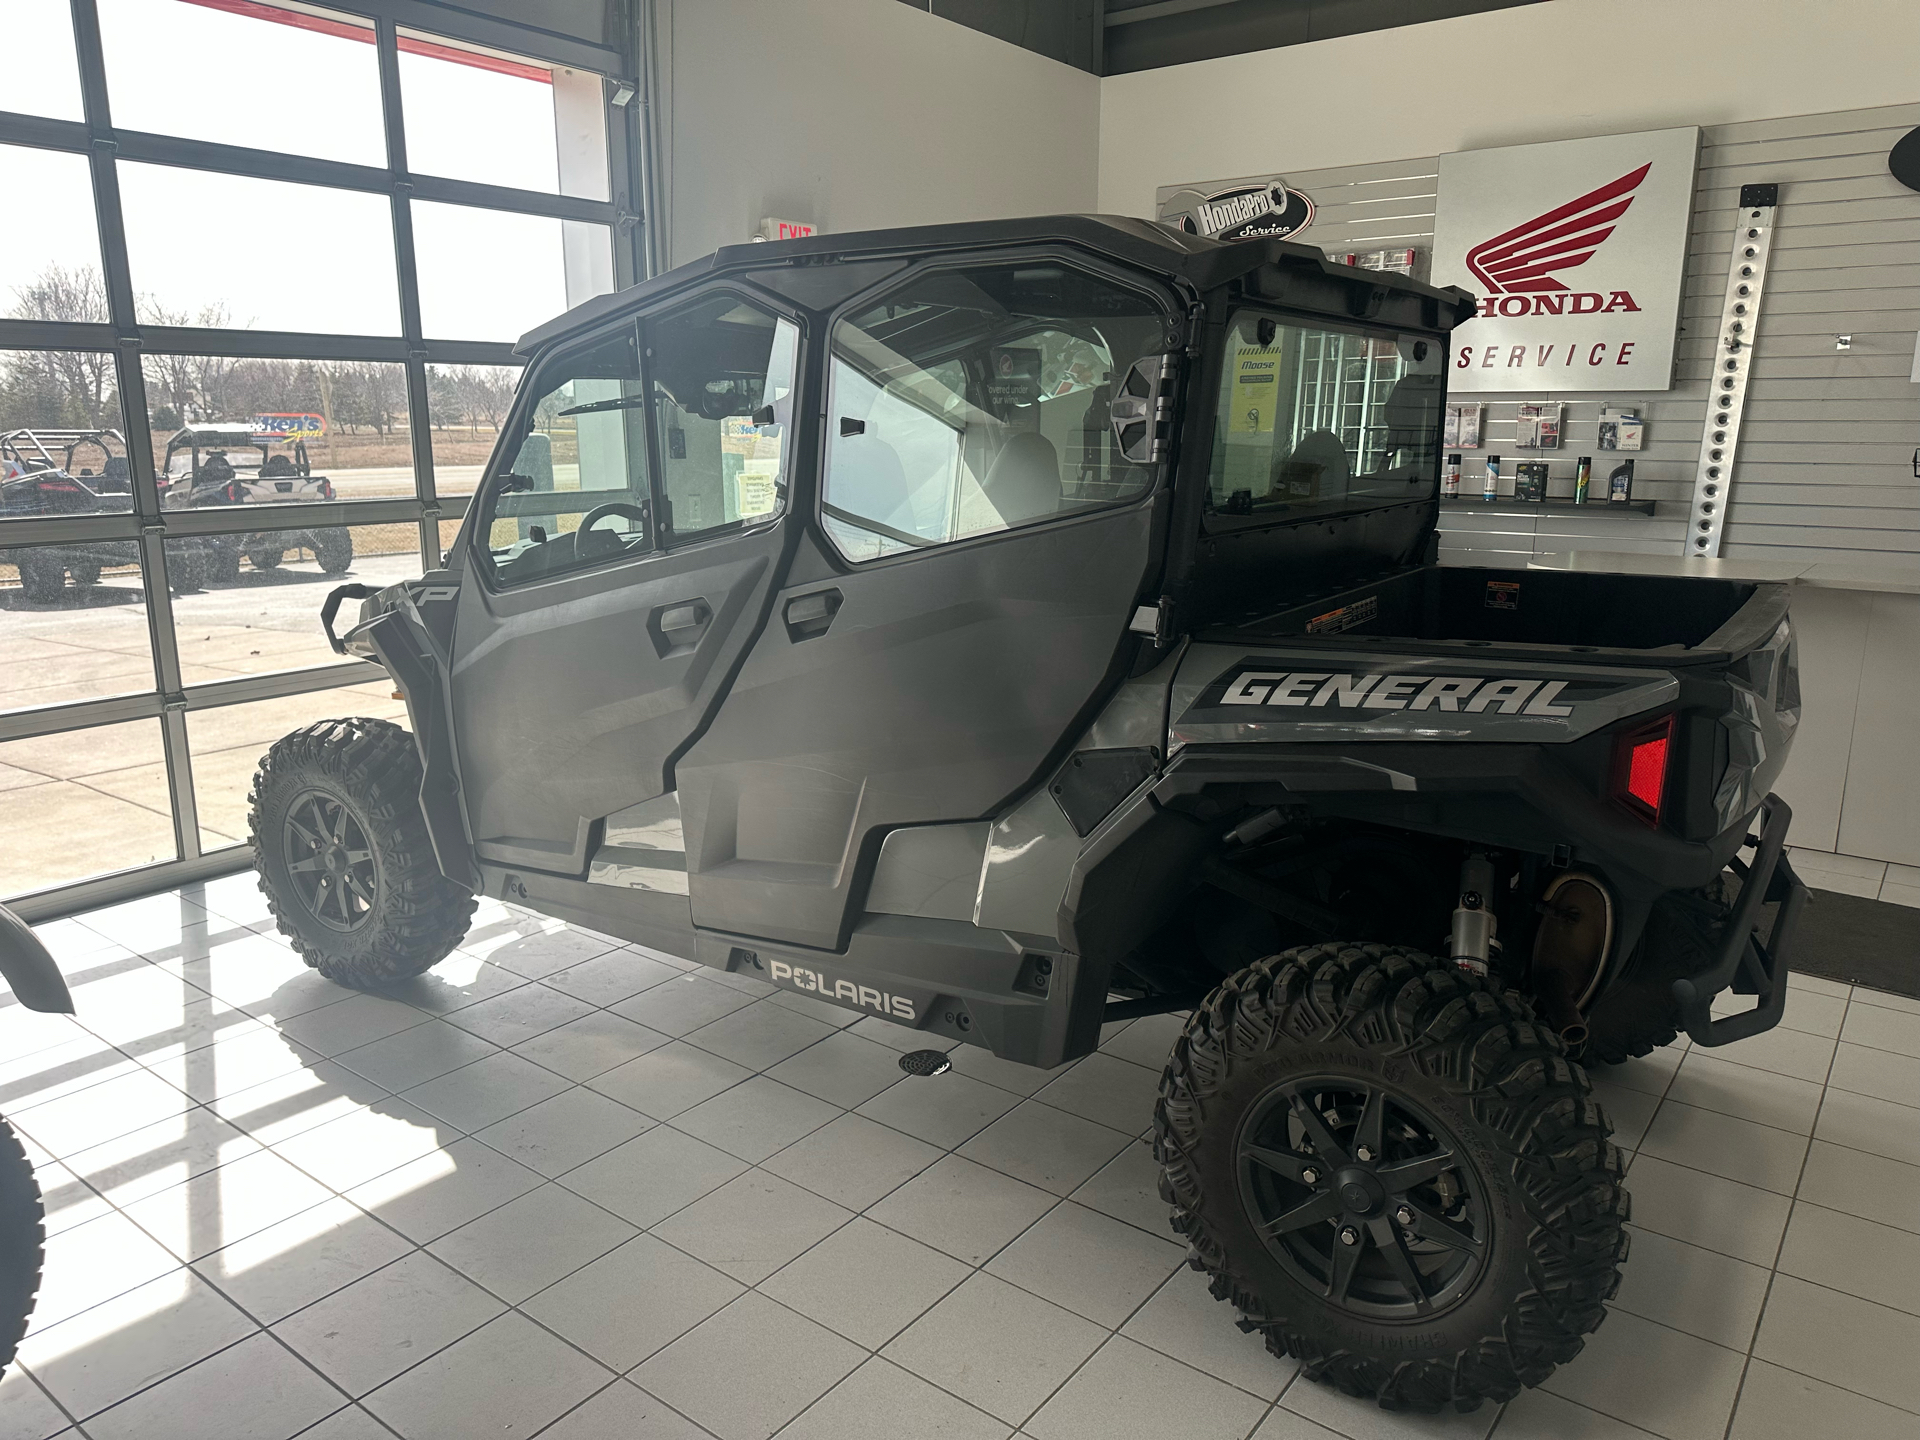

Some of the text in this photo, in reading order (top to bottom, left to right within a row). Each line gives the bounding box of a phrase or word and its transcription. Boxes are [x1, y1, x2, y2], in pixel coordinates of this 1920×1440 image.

[1197, 193, 1270, 236] HondaPro
[1239, 223, 1291, 237] Service
[1472, 291, 1642, 318] HONDA
[1457, 343, 1635, 368] SERVICE
[986, 384, 1010, 395] overed
[396, 586, 460, 607] XP
[1219, 671, 1576, 717] GENERAL
[770, 959, 916, 1020] POLARIS
